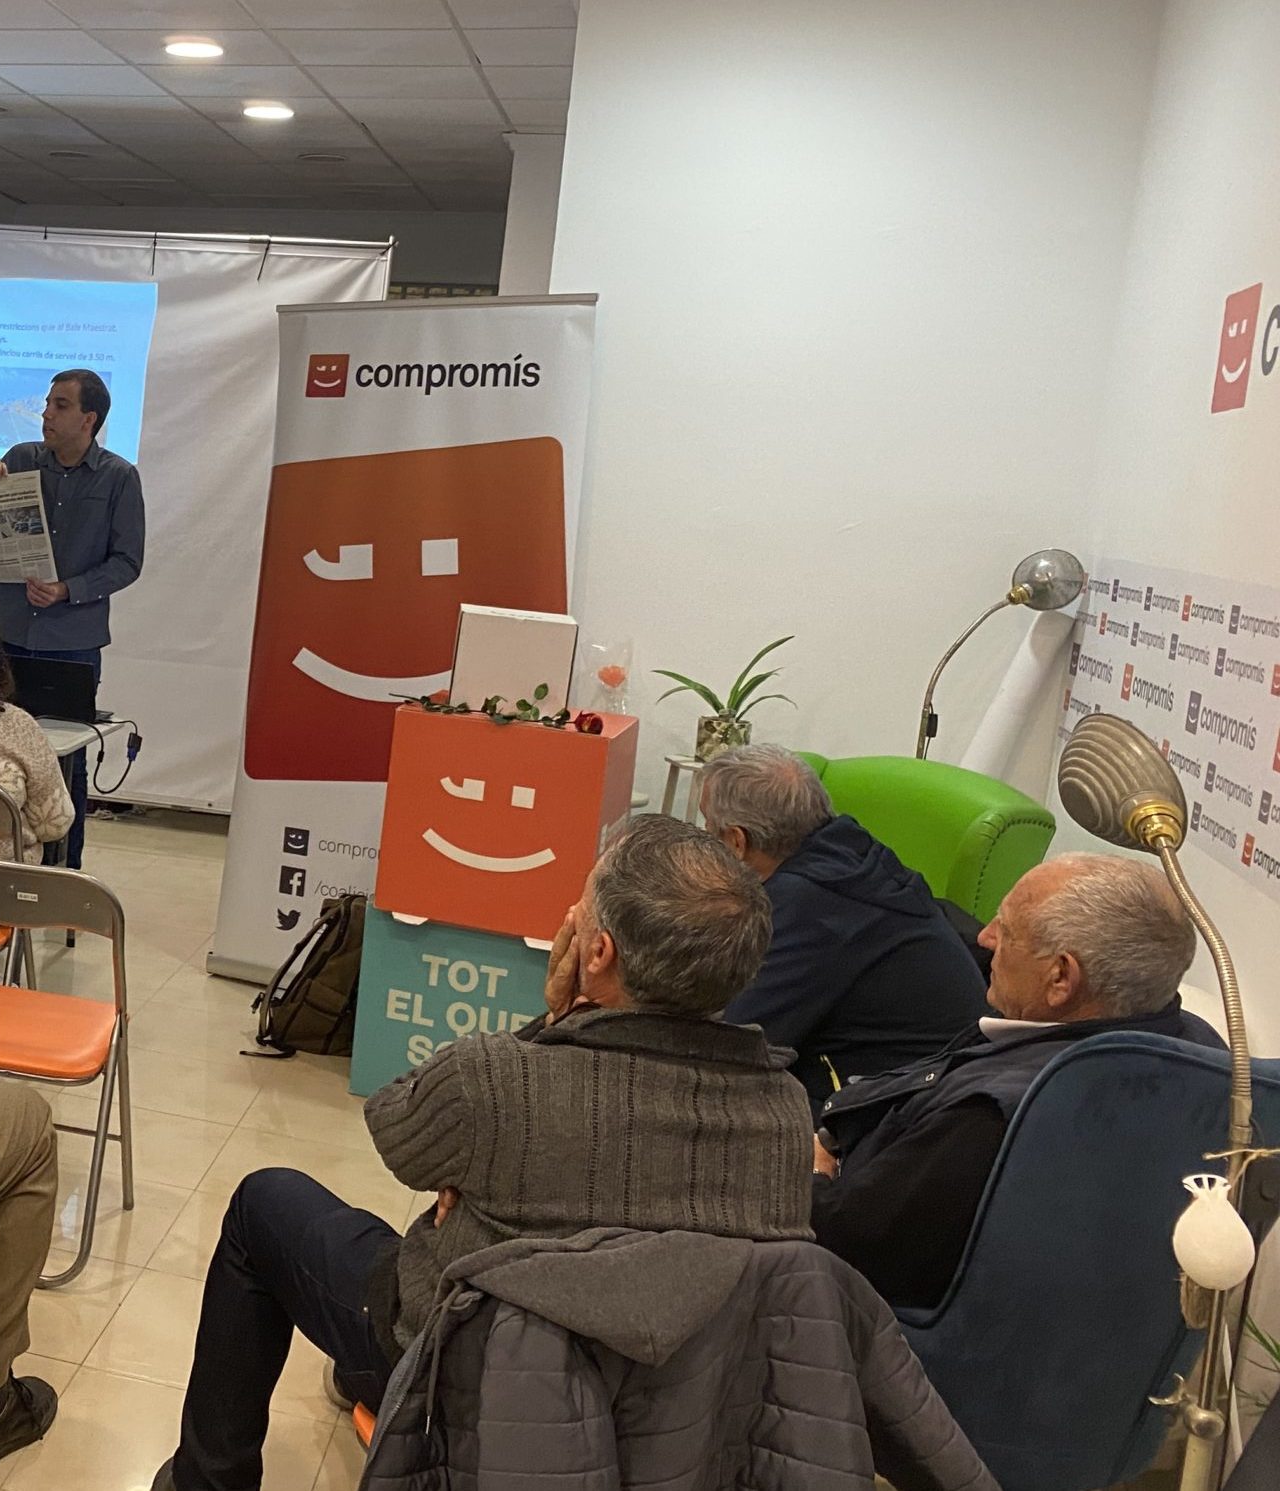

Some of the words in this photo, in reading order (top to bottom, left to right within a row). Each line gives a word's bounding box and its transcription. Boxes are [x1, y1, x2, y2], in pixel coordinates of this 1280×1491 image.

[355, 353, 541, 395] compromís
[1079, 653, 1113, 684] compromís
[1225, 655, 1265, 684] compromís
[1132, 676, 1174, 712] compromís
[1200, 706, 1257, 751] compromís
[1215, 773, 1253, 807] compromís
[318, 839, 381, 860] compro
[1200, 812, 1237, 850] compromís
[422, 954, 508, 998] TOT
[386, 988, 434, 1028] EL
